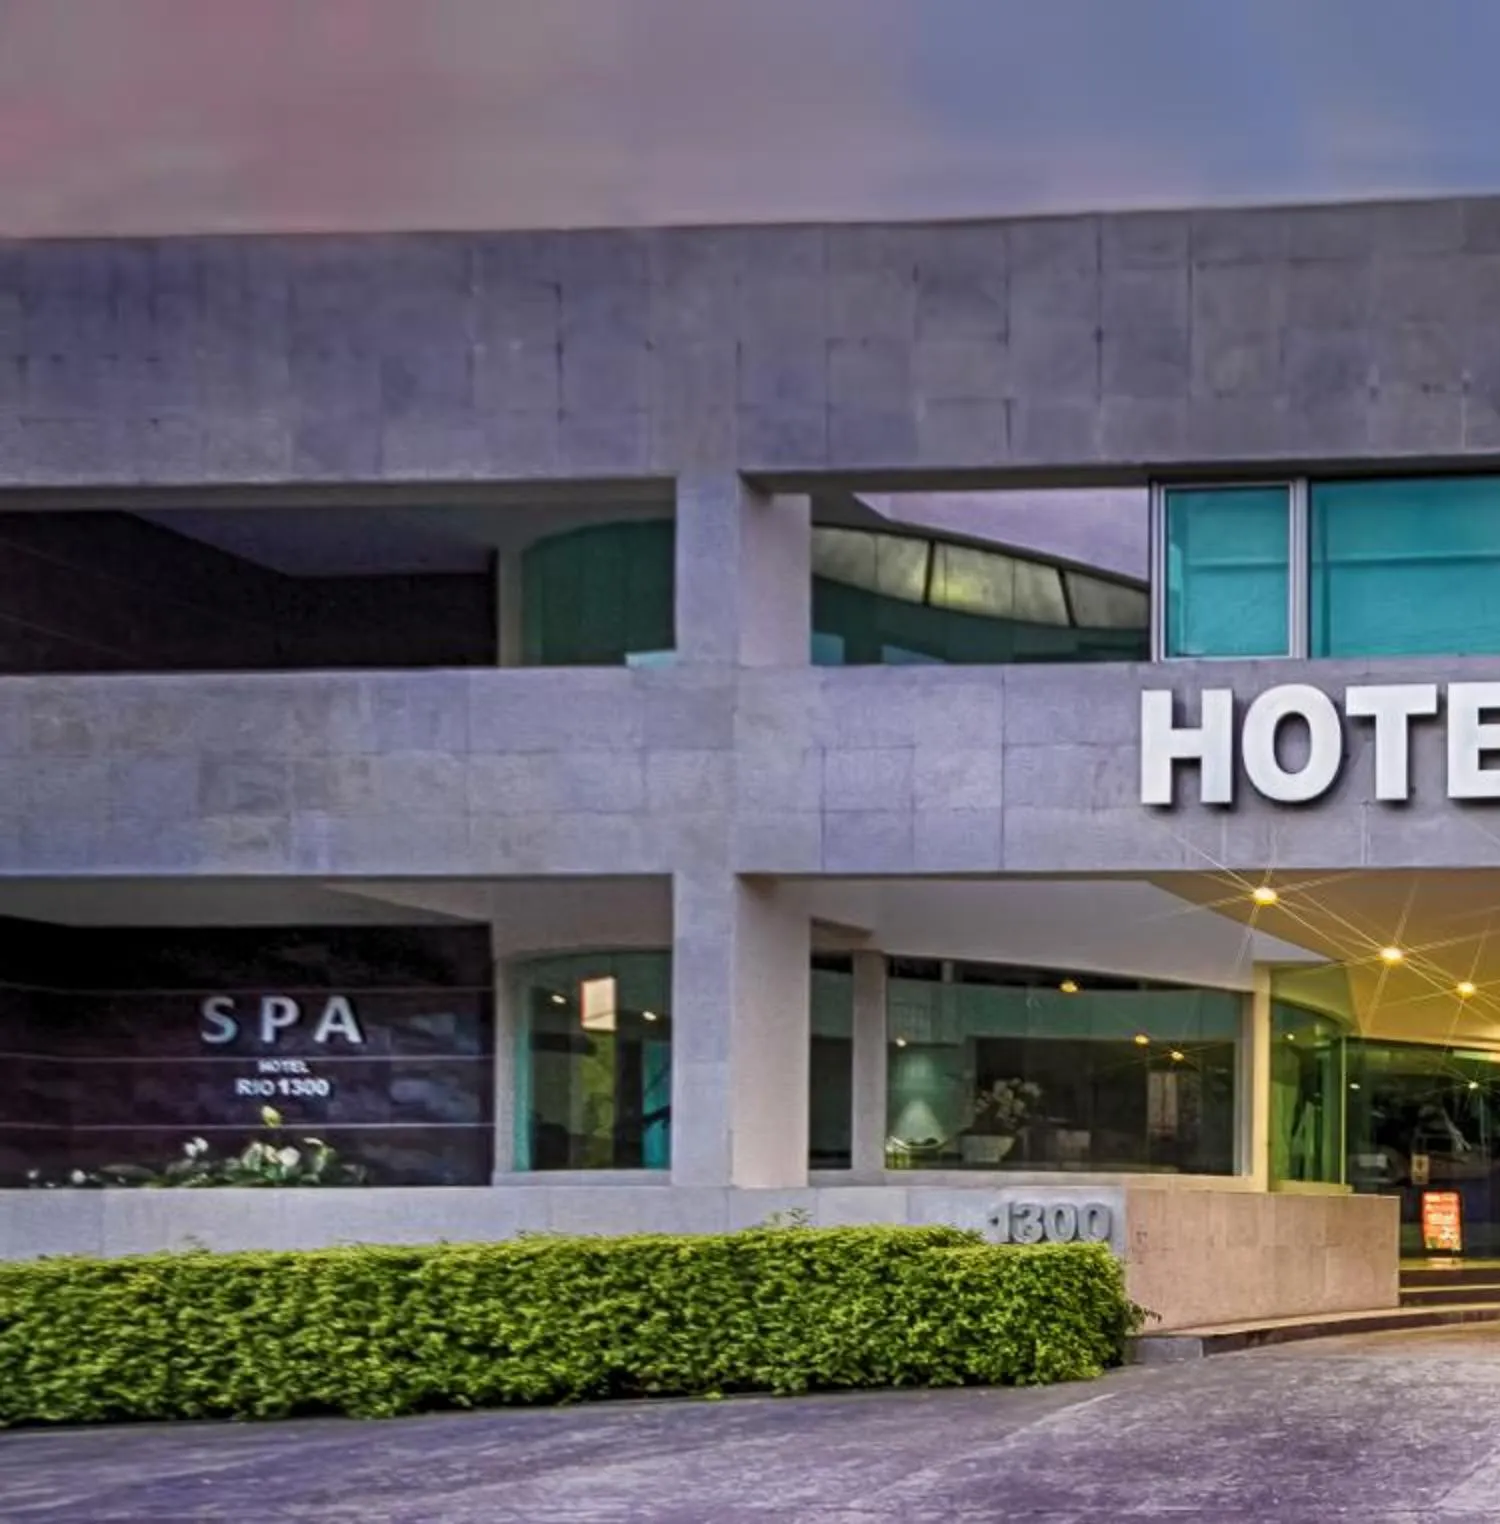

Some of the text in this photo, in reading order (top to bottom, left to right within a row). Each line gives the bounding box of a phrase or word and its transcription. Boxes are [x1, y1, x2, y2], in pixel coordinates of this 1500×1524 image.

[201, 995, 363, 1044] SPA
[258, 1060, 310, 1073] HOTEL
[236, 1079, 330, 1096] RIO 1300
[987, 1202, 1113, 1244] 1300
